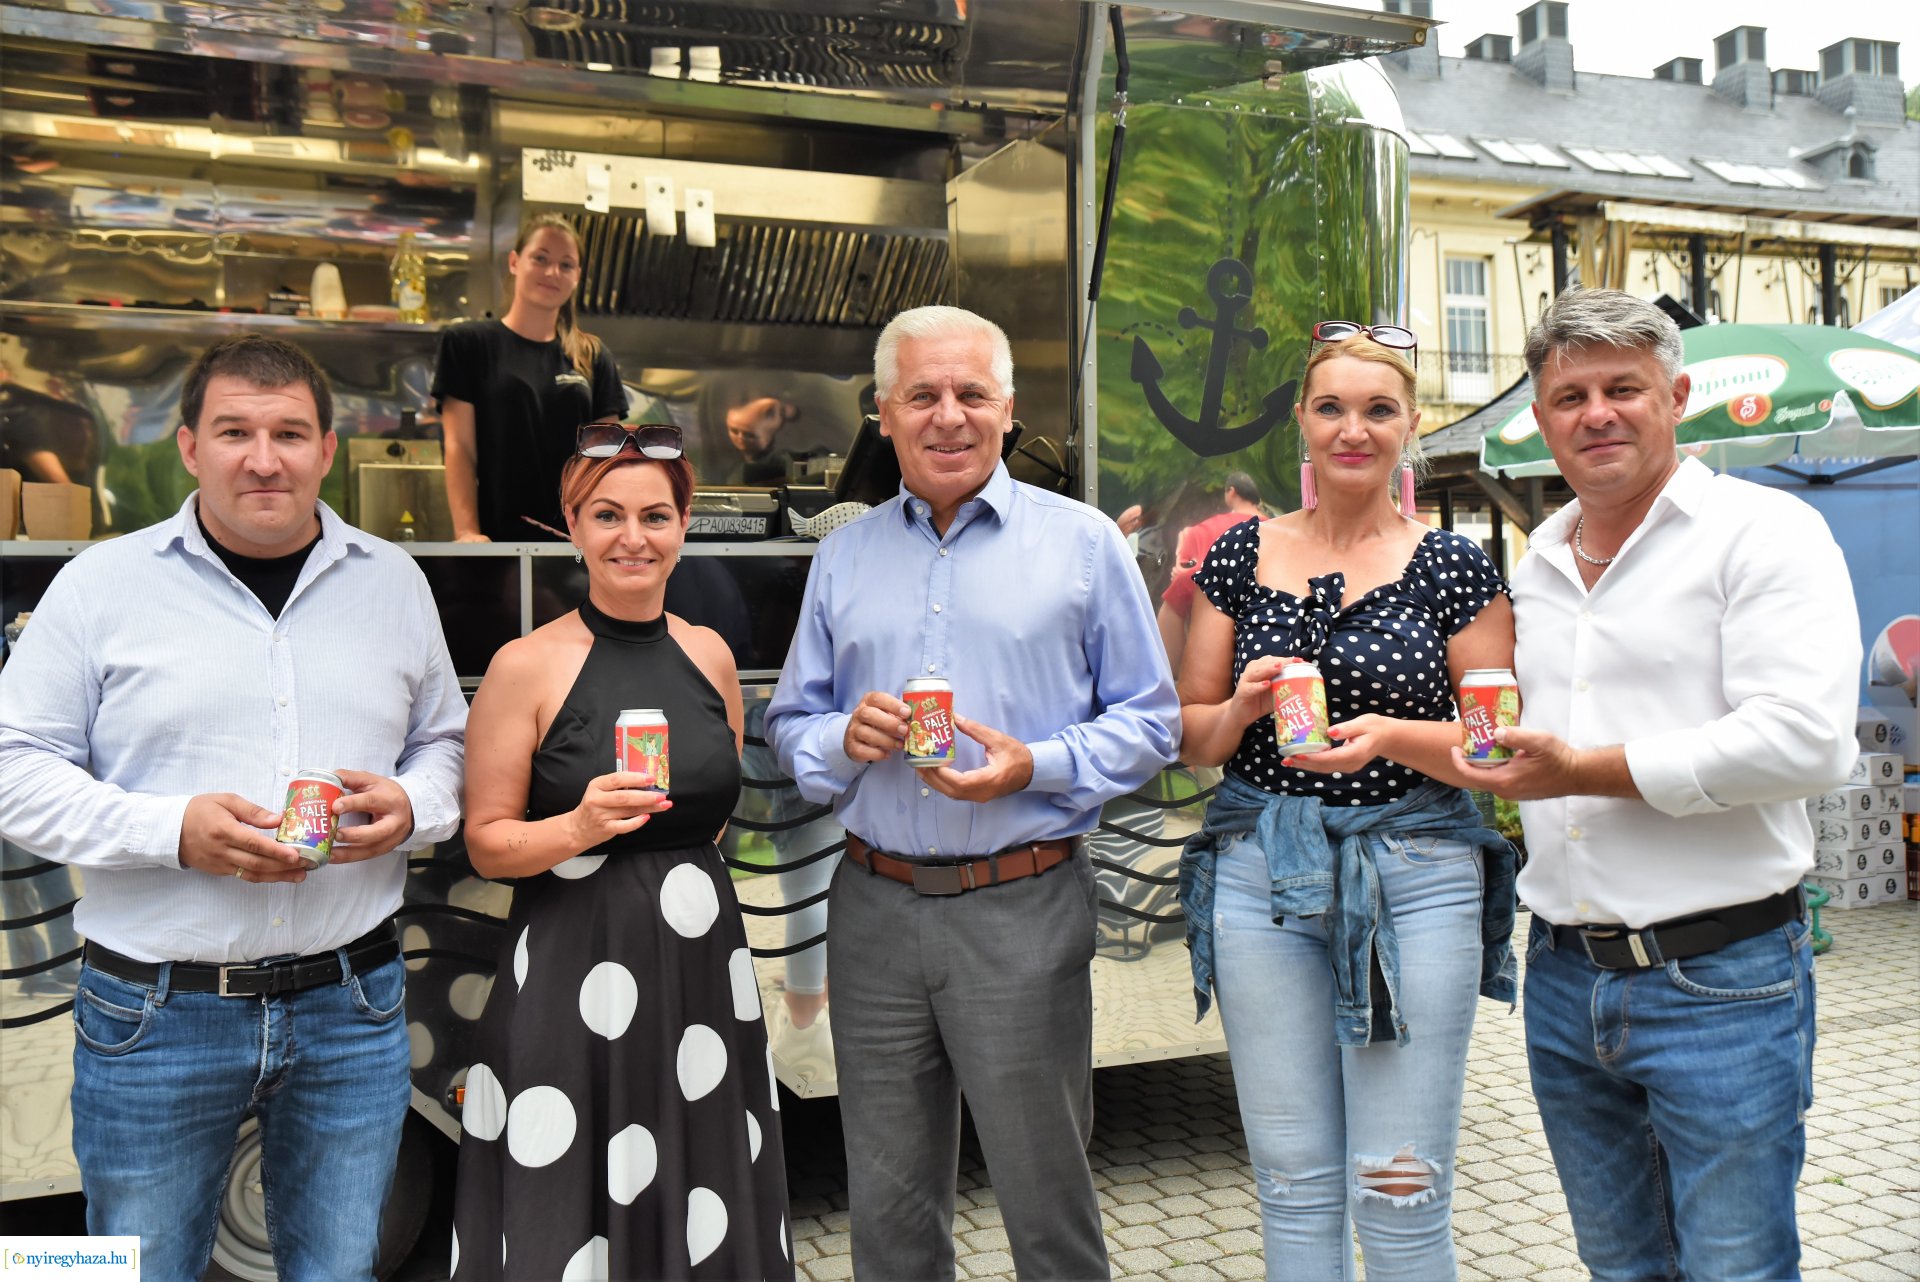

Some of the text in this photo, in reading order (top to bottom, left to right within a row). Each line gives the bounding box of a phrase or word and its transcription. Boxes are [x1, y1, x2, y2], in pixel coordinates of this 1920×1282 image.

[1690, 369, 1771, 395] oproni
[1280, 698, 1306, 719] PALE
[924, 712, 948, 731] PALE
[1287, 710, 1313, 733] ALE
[1465, 709, 1490, 729] PALE
[931, 725, 952, 745] ALE
[1470, 723, 1494, 745] ALE
[301, 803, 328, 818] PALE
[303, 818, 328, 834] ALE
